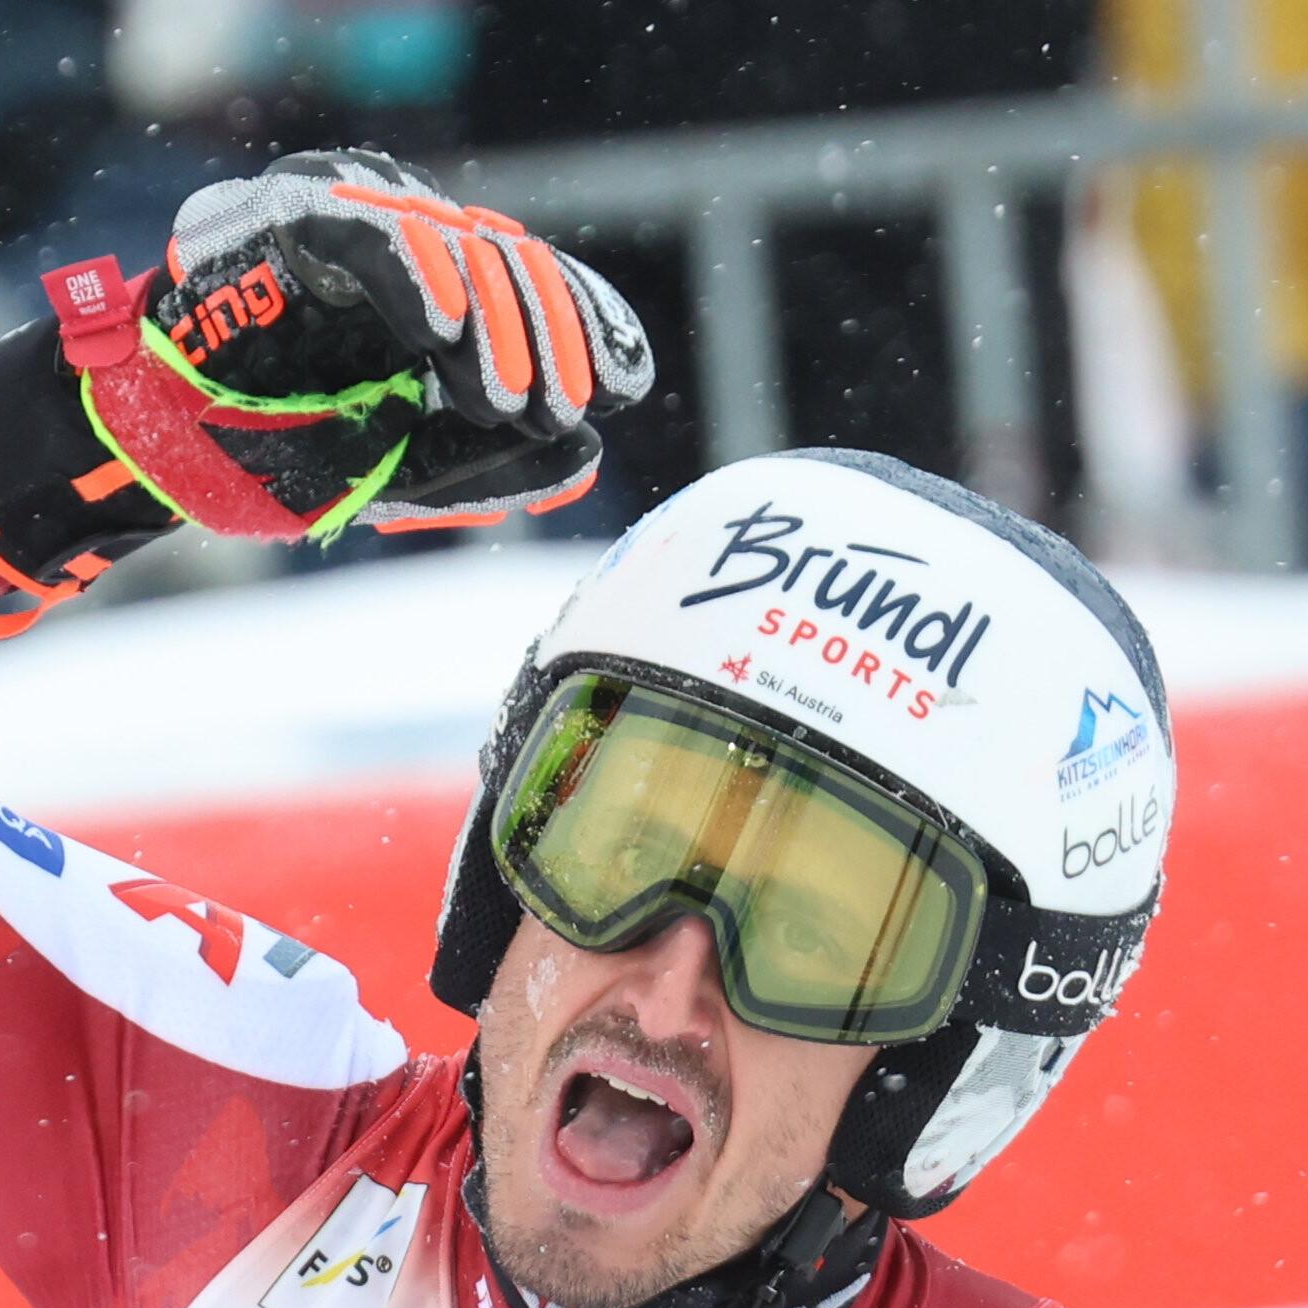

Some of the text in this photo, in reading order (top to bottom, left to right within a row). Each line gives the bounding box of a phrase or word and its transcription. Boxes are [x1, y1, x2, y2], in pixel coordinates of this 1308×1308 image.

[65, 269, 99, 292] ONE
[70, 281, 105, 305] SIZE
[757, 608, 936, 720] SPORTS
[756, 670, 844, 724] Ski Austria
[1062, 784, 1158, 879] bollé
